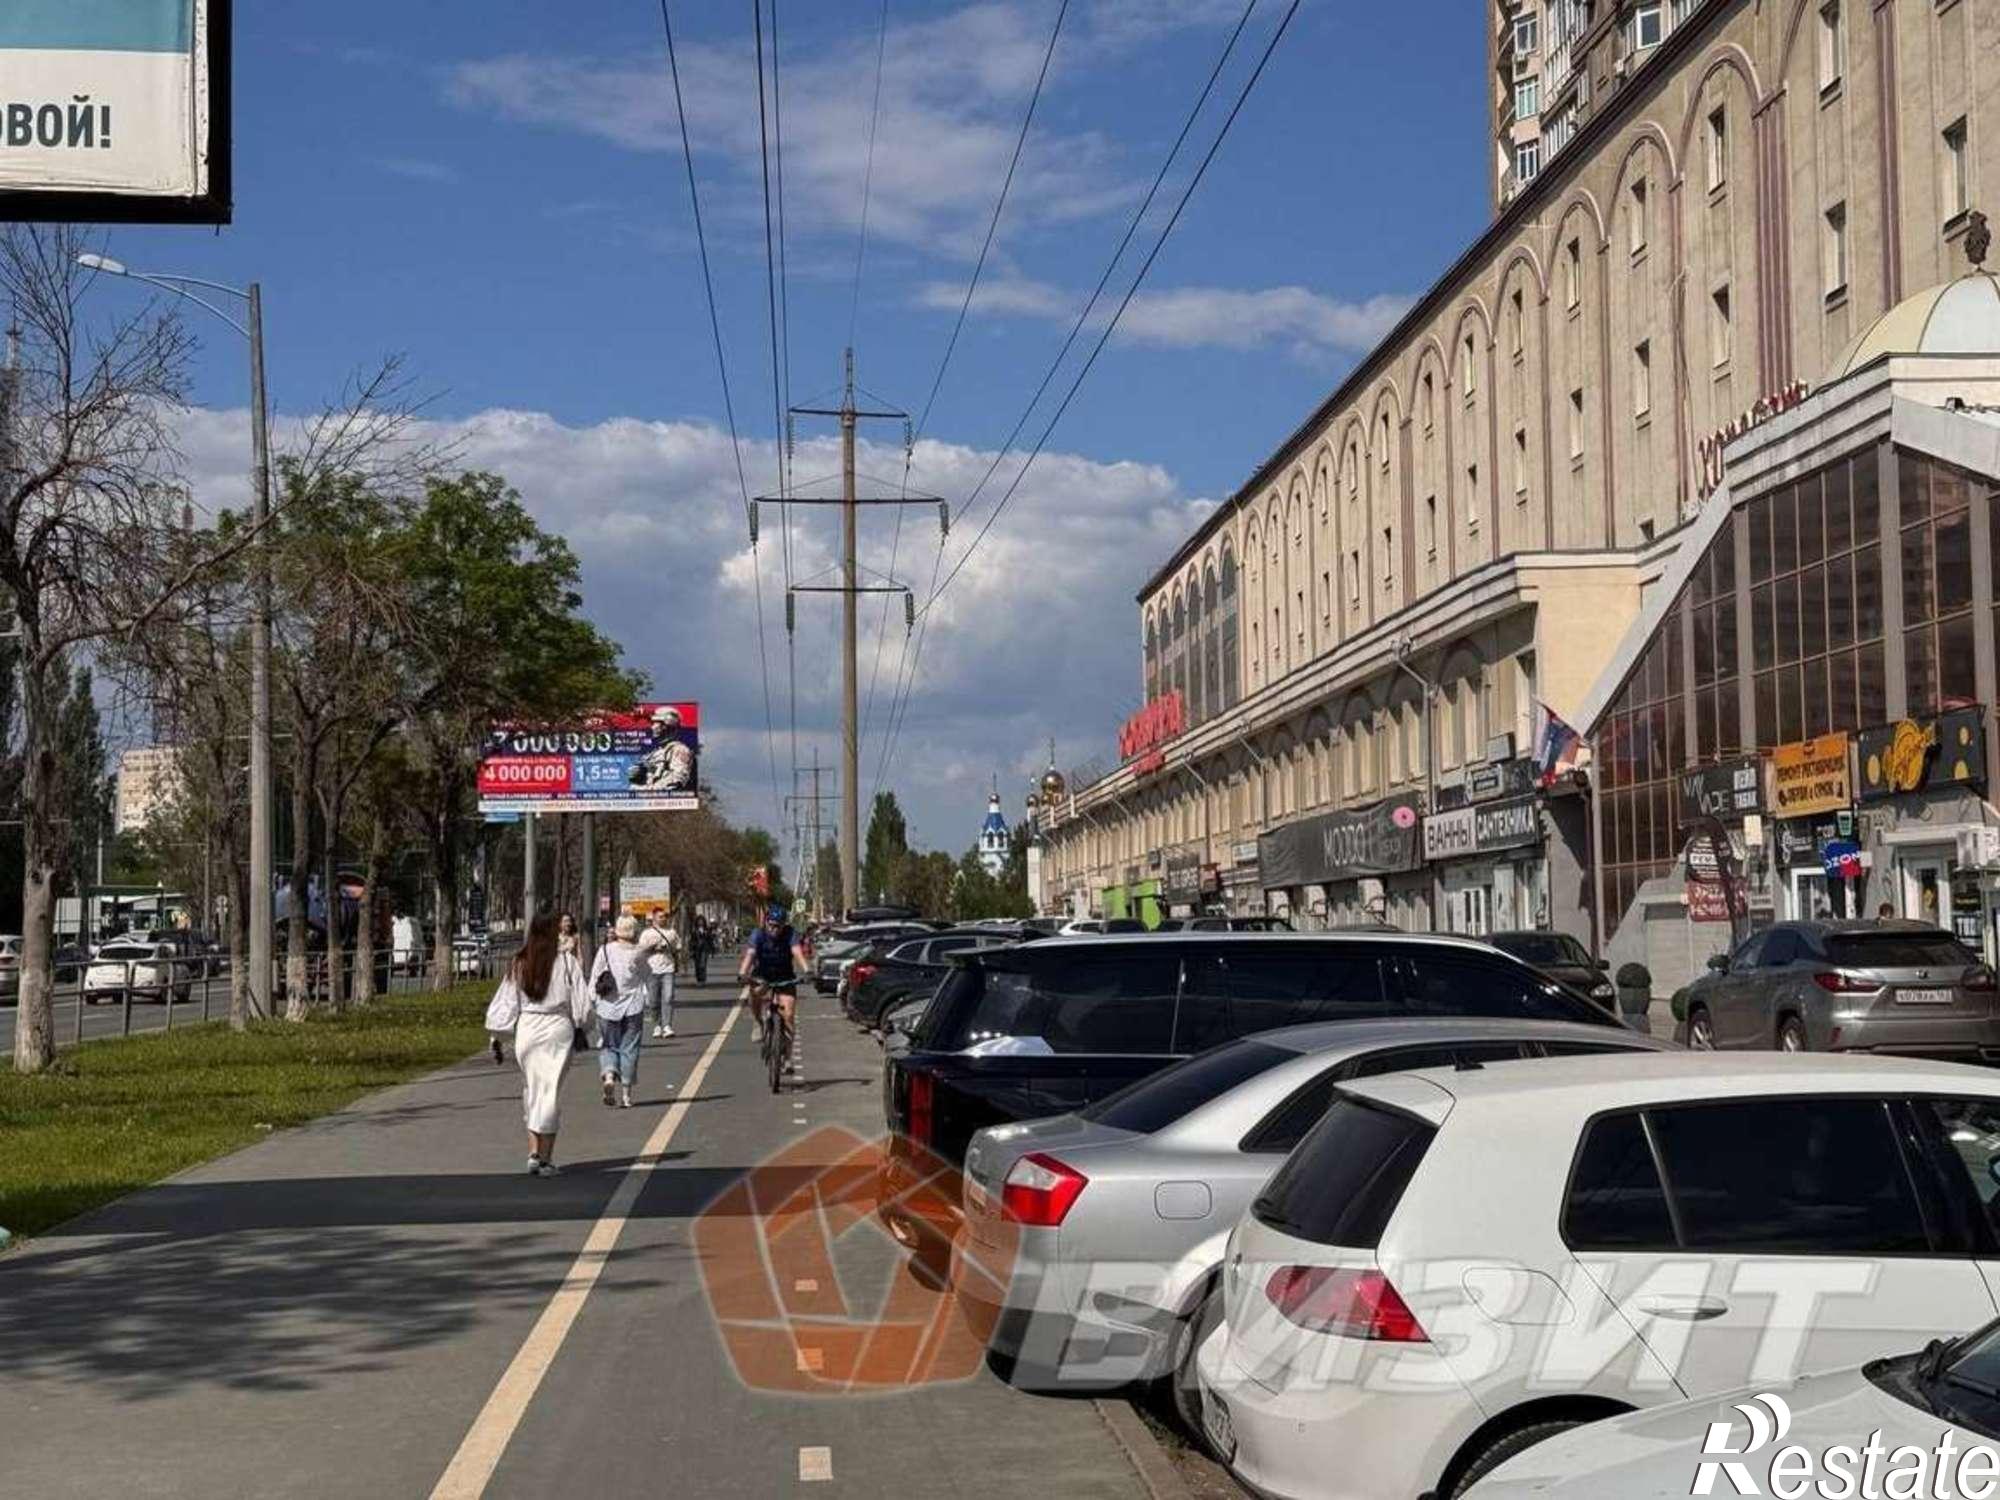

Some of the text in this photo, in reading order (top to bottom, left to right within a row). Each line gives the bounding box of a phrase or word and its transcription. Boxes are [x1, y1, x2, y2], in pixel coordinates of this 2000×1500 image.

[0, 94, 111, 148] ВОЙ!
[484, 764, 567, 781] 4 000 000
[576, 765, 601, 785] 1,5
[1427, 817, 1472, 852] ВАННЫ
